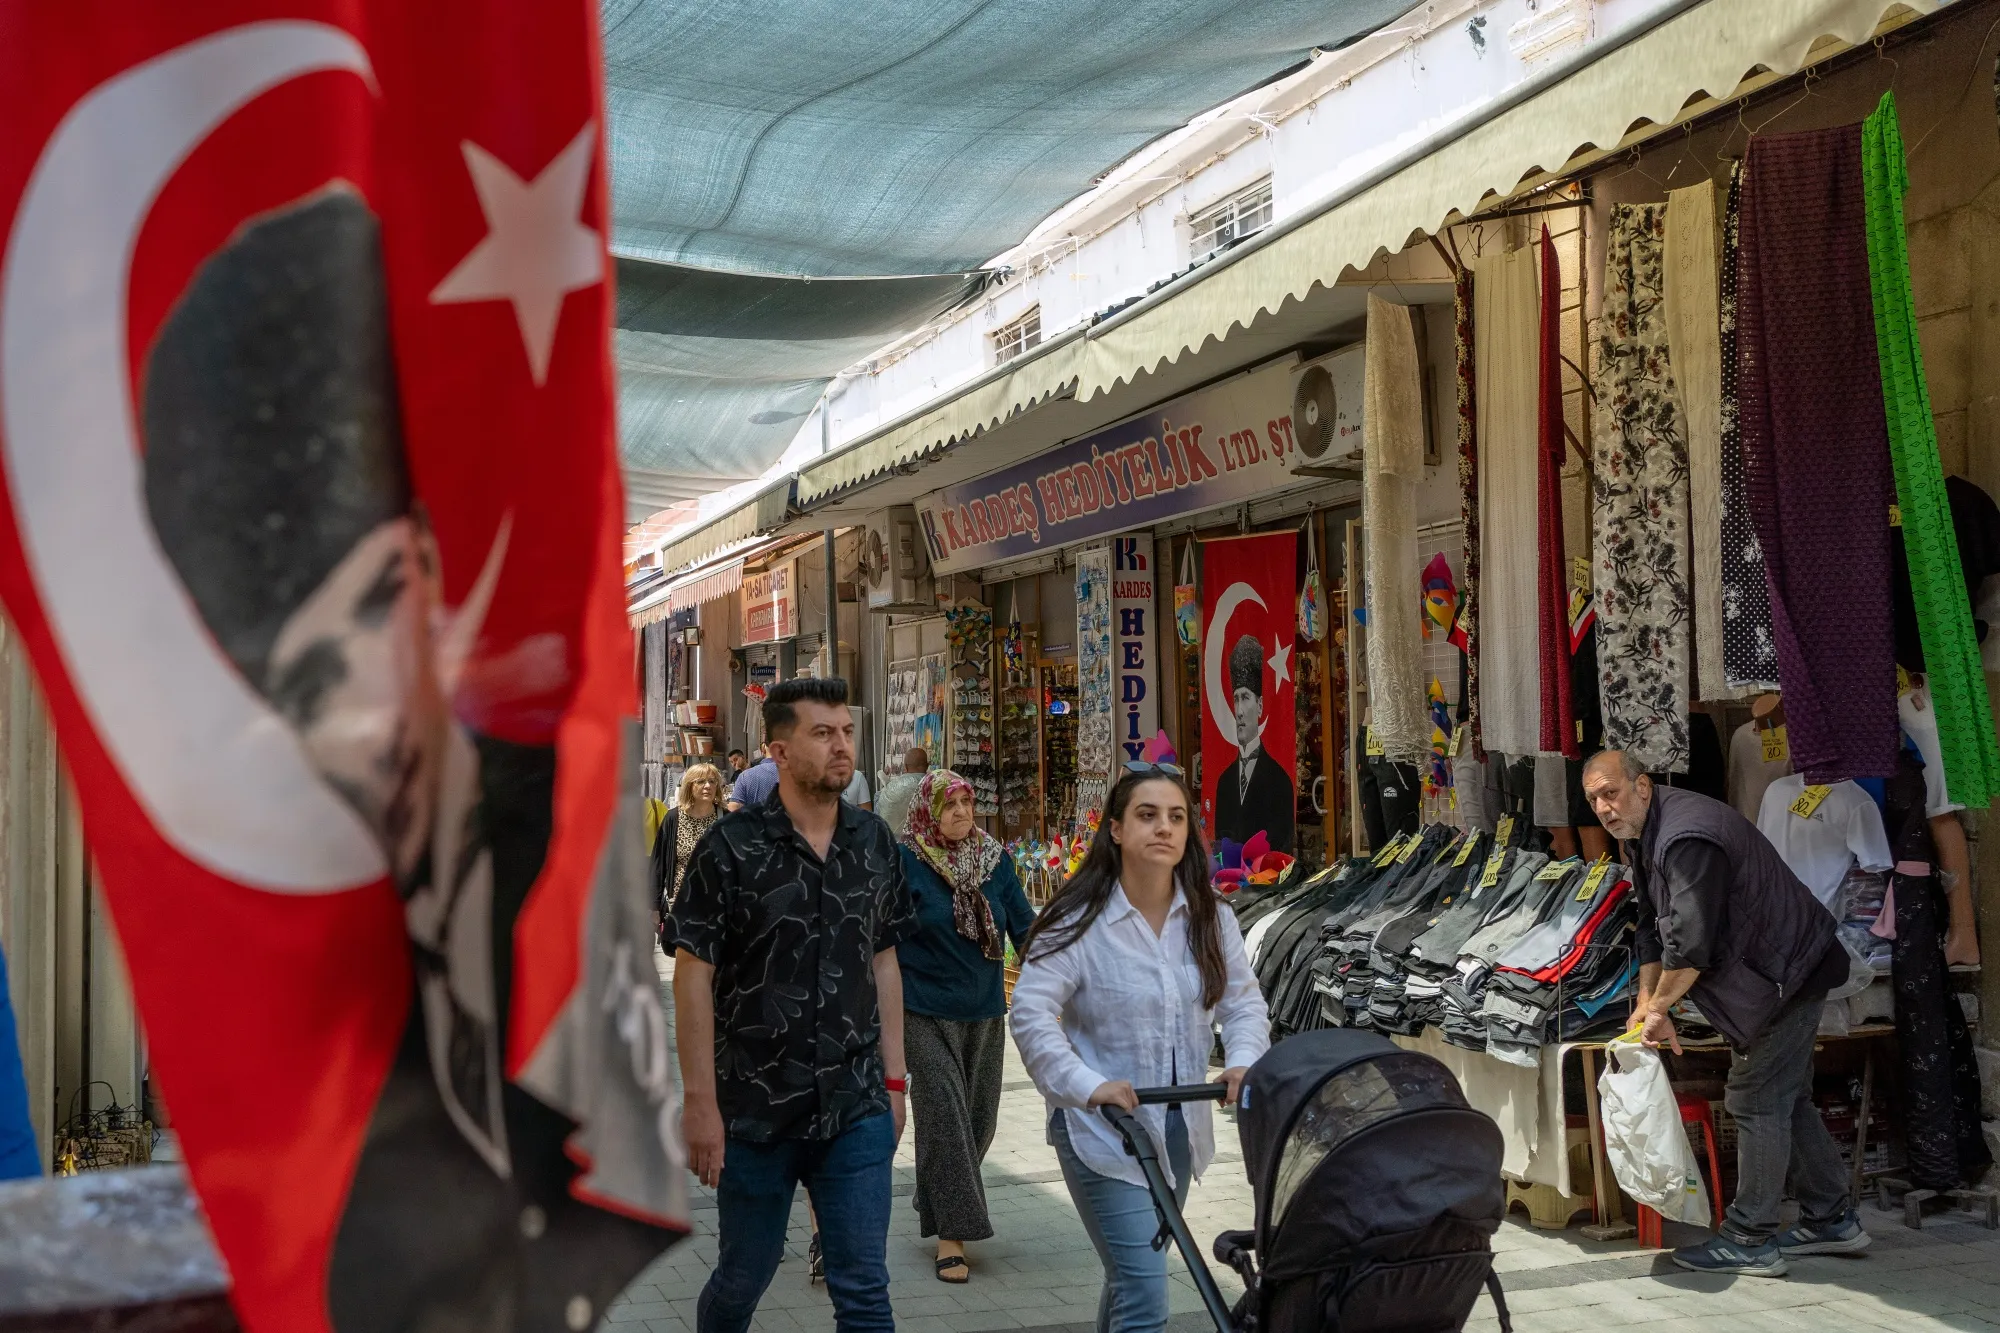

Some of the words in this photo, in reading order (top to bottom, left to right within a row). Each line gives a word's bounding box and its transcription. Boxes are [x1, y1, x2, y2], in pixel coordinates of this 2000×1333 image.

[941, 483, 1041, 544] KARDEŞ
[1037, 419, 1218, 526] HEDİYELİK
[1218, 427, 1268, 472] LTD.
[1113, 581, 1152, 602] KARDEŞ
[1767, 747, 1781, 758] 80
[1792, 797, 1810, 813] 80
